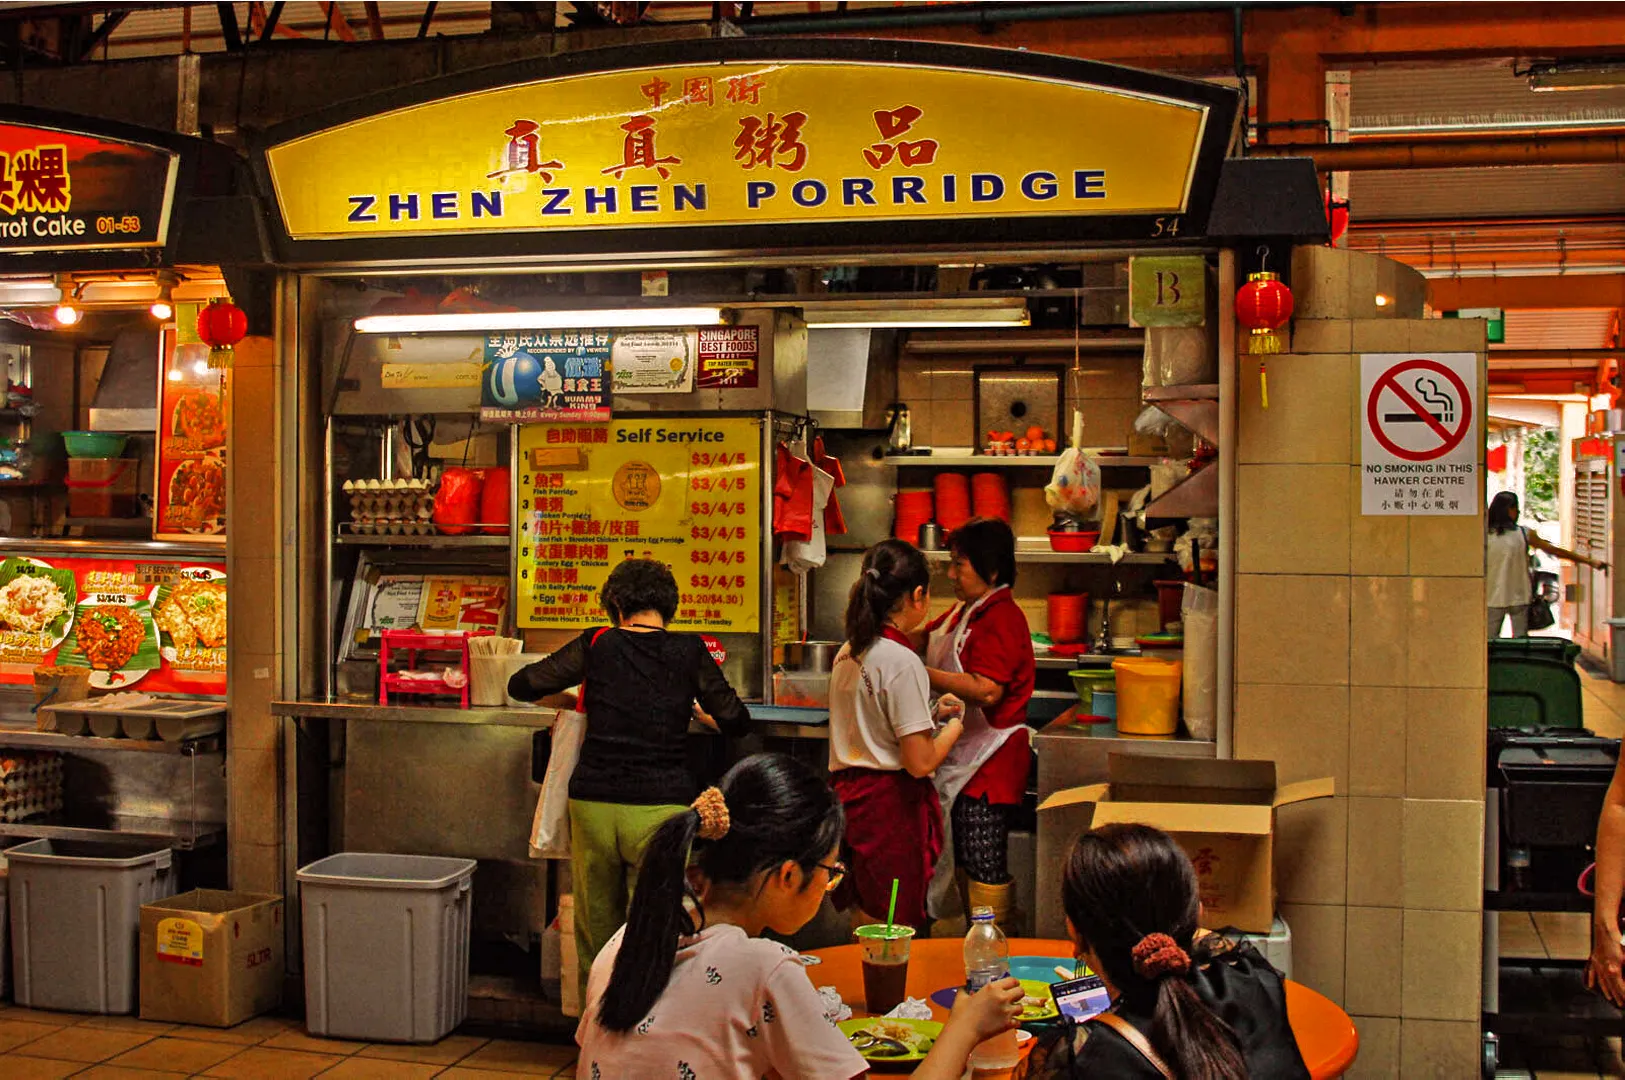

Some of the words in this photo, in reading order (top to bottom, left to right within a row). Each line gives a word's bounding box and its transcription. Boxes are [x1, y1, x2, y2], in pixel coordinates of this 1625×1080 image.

[641, 75, 767, 106] 中國街
[487, 104, 939, 184] 真真粥品
[347, 190, 504, 222] ZHEN
[541, 184, 706, 215] ZHEN
[746, 169, 1107, 208] PORRIDGE
[33, 215, 86, 236] Cake
[96, 216, 141, 234] 01-53
[1152, 217, 1180, 238] 54
[700, 329, 757, 341] SINGAPORE
[701, 342, 723, 352] BEST
[726, 341, 755, 352] FOODS
[616, 428, 652, 444] Self
[656, 428, 725, 443] Service
[524, 450, 528, 460] 1
[692, 452, 746, 468] $3/4/5
[1366, 464, 1382, 473] NO
[1384, 464, 1434, 473] SMOKING
[1436, 464, 1446, 473] IN
[1450, 464, 1473, 473] THIS
[522, 474, 530, 485] 2
[692, 476, 746, 492] $3/4/5
[1374, 476, 1420, 484] HAWKER
[1422, 476, 1465, 484] CENTRE
[549, 488, 578, 496] Porridge
[522, 500, 529, 510] 3
[691, 502, 746, 518] $3/4/5
[522, 522, 528, 532] 4
[690, 526, 746, 542] $3/4/5
[522, 547, 528, 556] 5
[690, 550, 746, 566] $3/4/5
[522, 570, 528, 579] 6
[690, 574, 746, 590] $3/4/5
[539, 594, 556, 604] Egg
